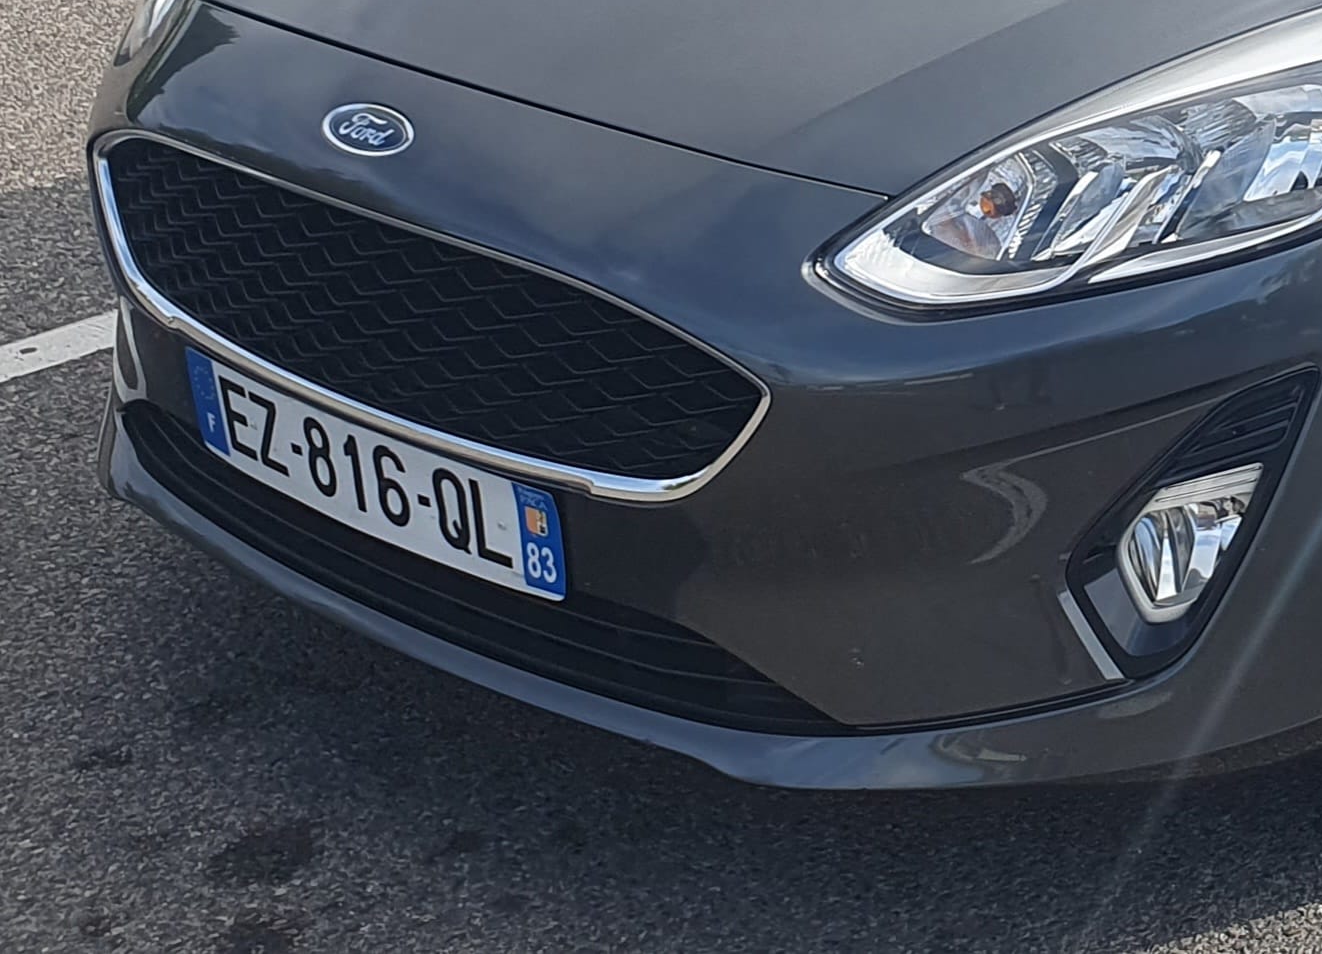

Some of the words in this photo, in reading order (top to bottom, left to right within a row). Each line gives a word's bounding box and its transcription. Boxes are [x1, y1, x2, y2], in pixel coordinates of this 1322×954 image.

[339, 113, 395, 146] Ford
[206, 412, 216, 433] F
[218, 375, 514, 570] EZ-816-QL
[526, 541, 557, 584] 83
